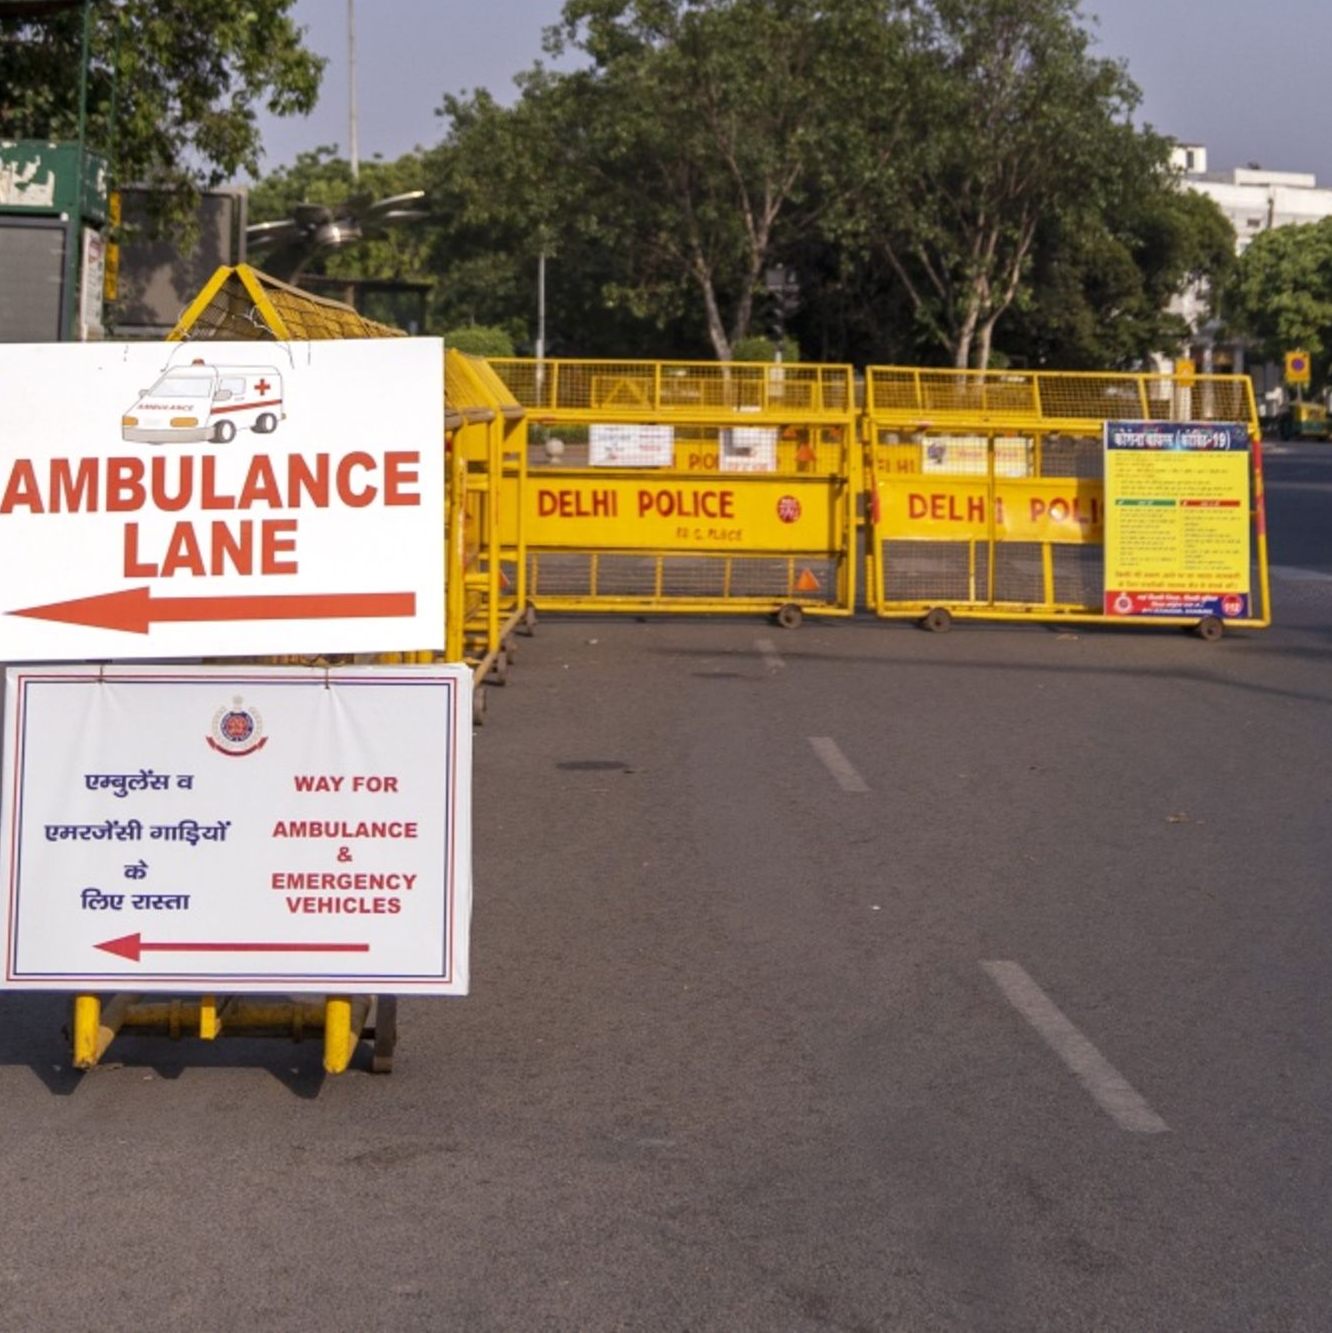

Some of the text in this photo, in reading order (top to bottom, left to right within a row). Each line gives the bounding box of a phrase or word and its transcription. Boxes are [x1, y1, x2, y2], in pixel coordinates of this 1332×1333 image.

[537, 490, 735, 518] DELHI POLICE
[908, 493, 1104, 524] DELHI POLI
[123, 519, 298, 578] LANE
[84, 769, 194, 798] एम्बुलेंस व
[294, 775, 399, 793] WAY FOR
[44, 819, 232, 846] एमरजेंसी गाड़ियों
[272, 820, 418, 838] AMBULANCE
[337, 846, 353, 862] &
[123, 859, 149, 880] के
[271, 873, 417, 890] EMERGENCY
[81, 888, 191, 911] लिए रास्ता
[286, 896, 402, 914] VEHICLES
